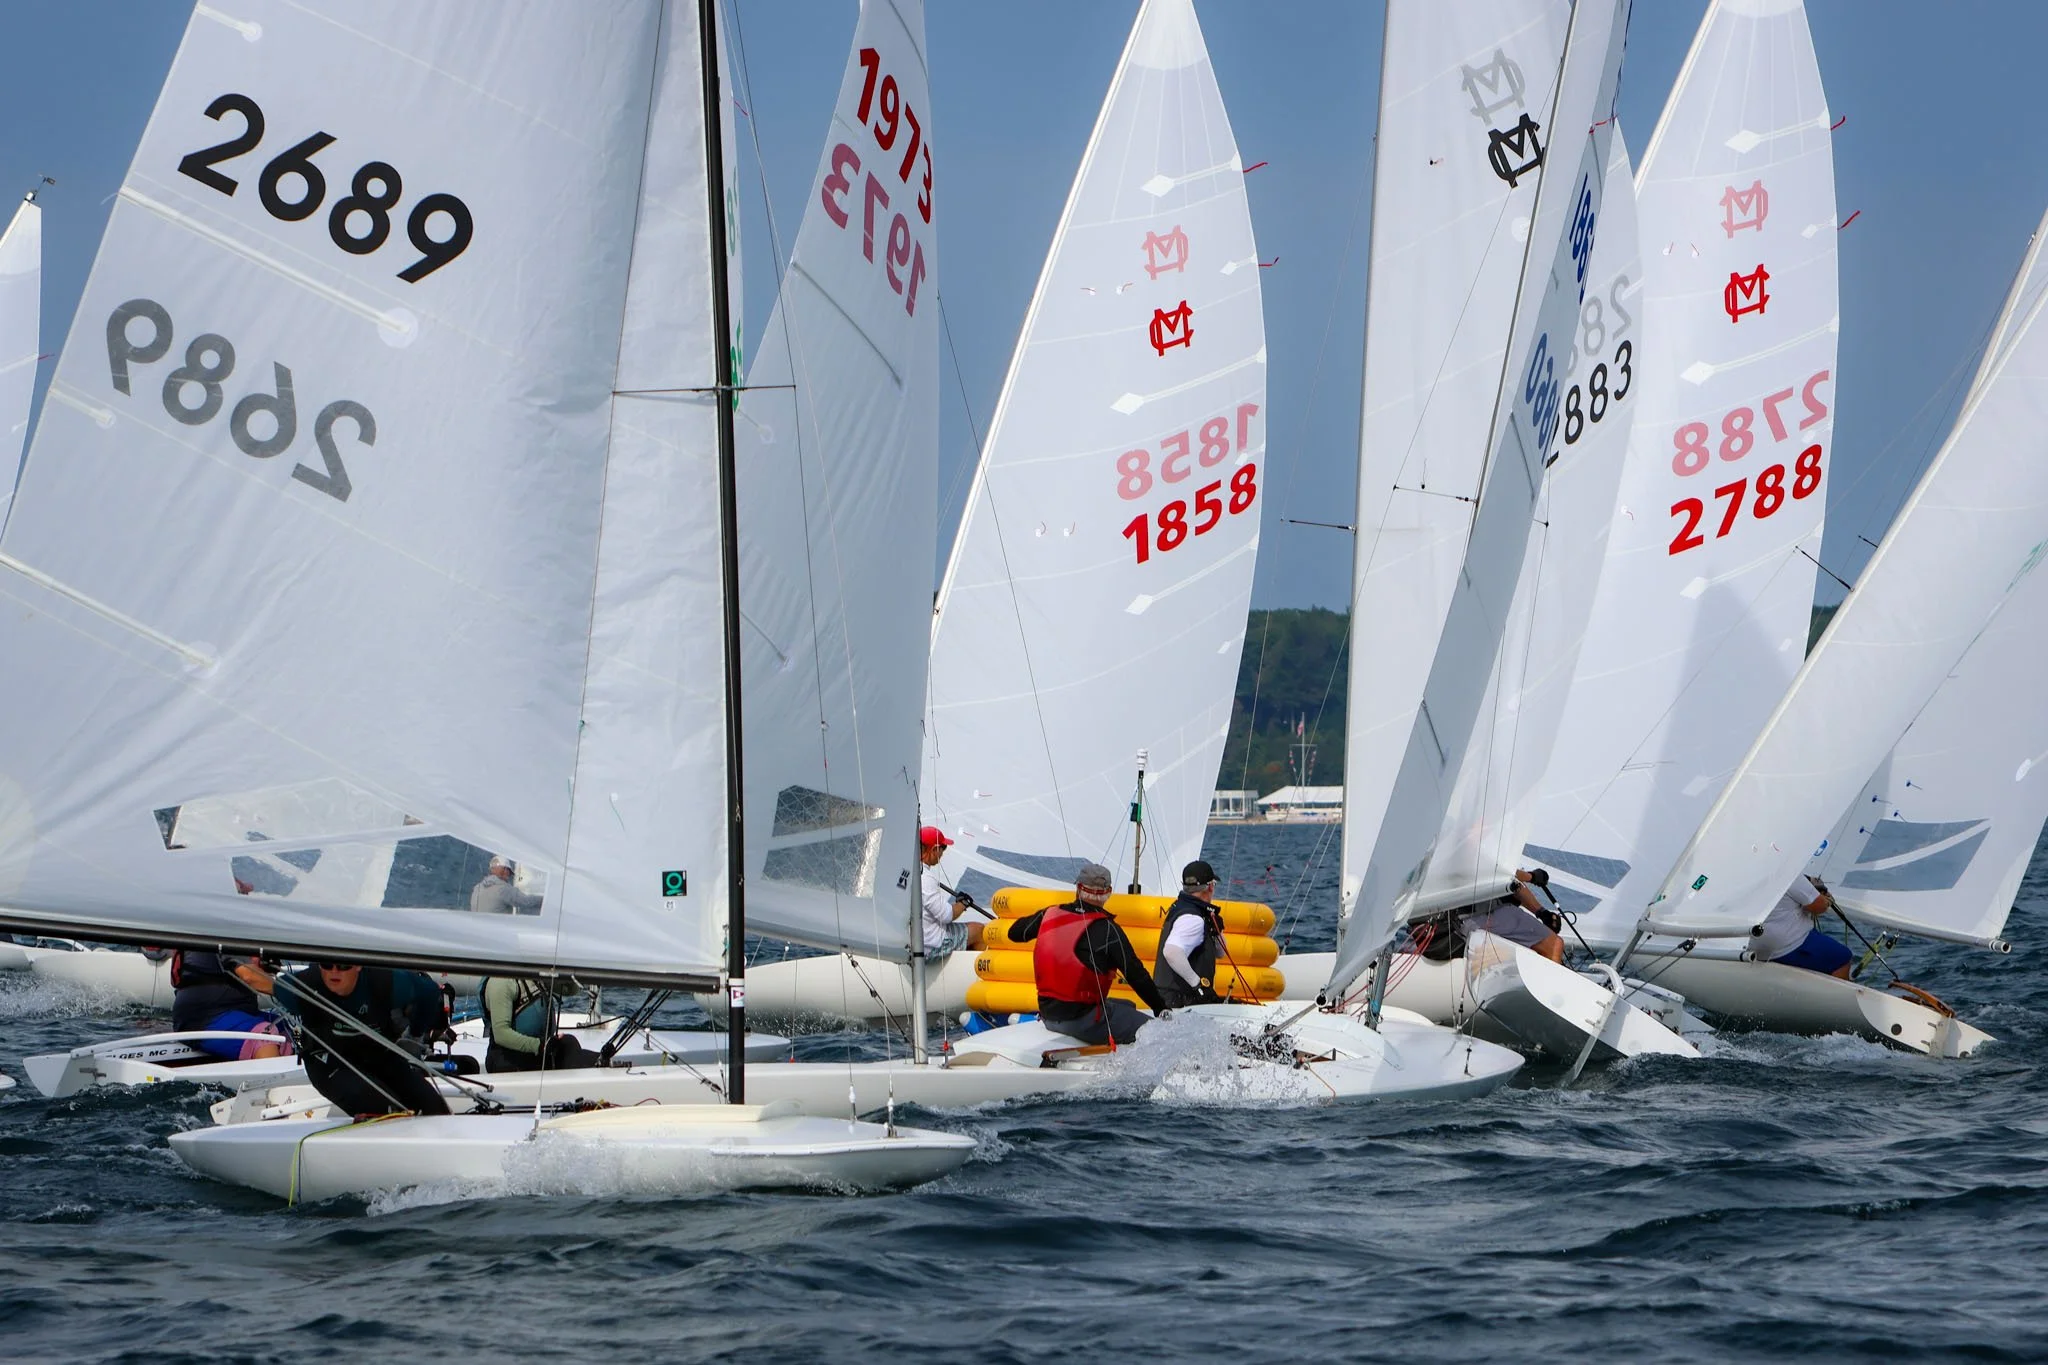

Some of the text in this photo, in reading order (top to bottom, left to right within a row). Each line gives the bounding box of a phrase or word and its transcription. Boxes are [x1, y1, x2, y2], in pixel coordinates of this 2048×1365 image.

[177, 93, 473, 284] 2689
[857, 48, 932, 224] 1973
[1122, 463, 1257, 564] 1858
[1669, 444, 1823, 556] 2788
